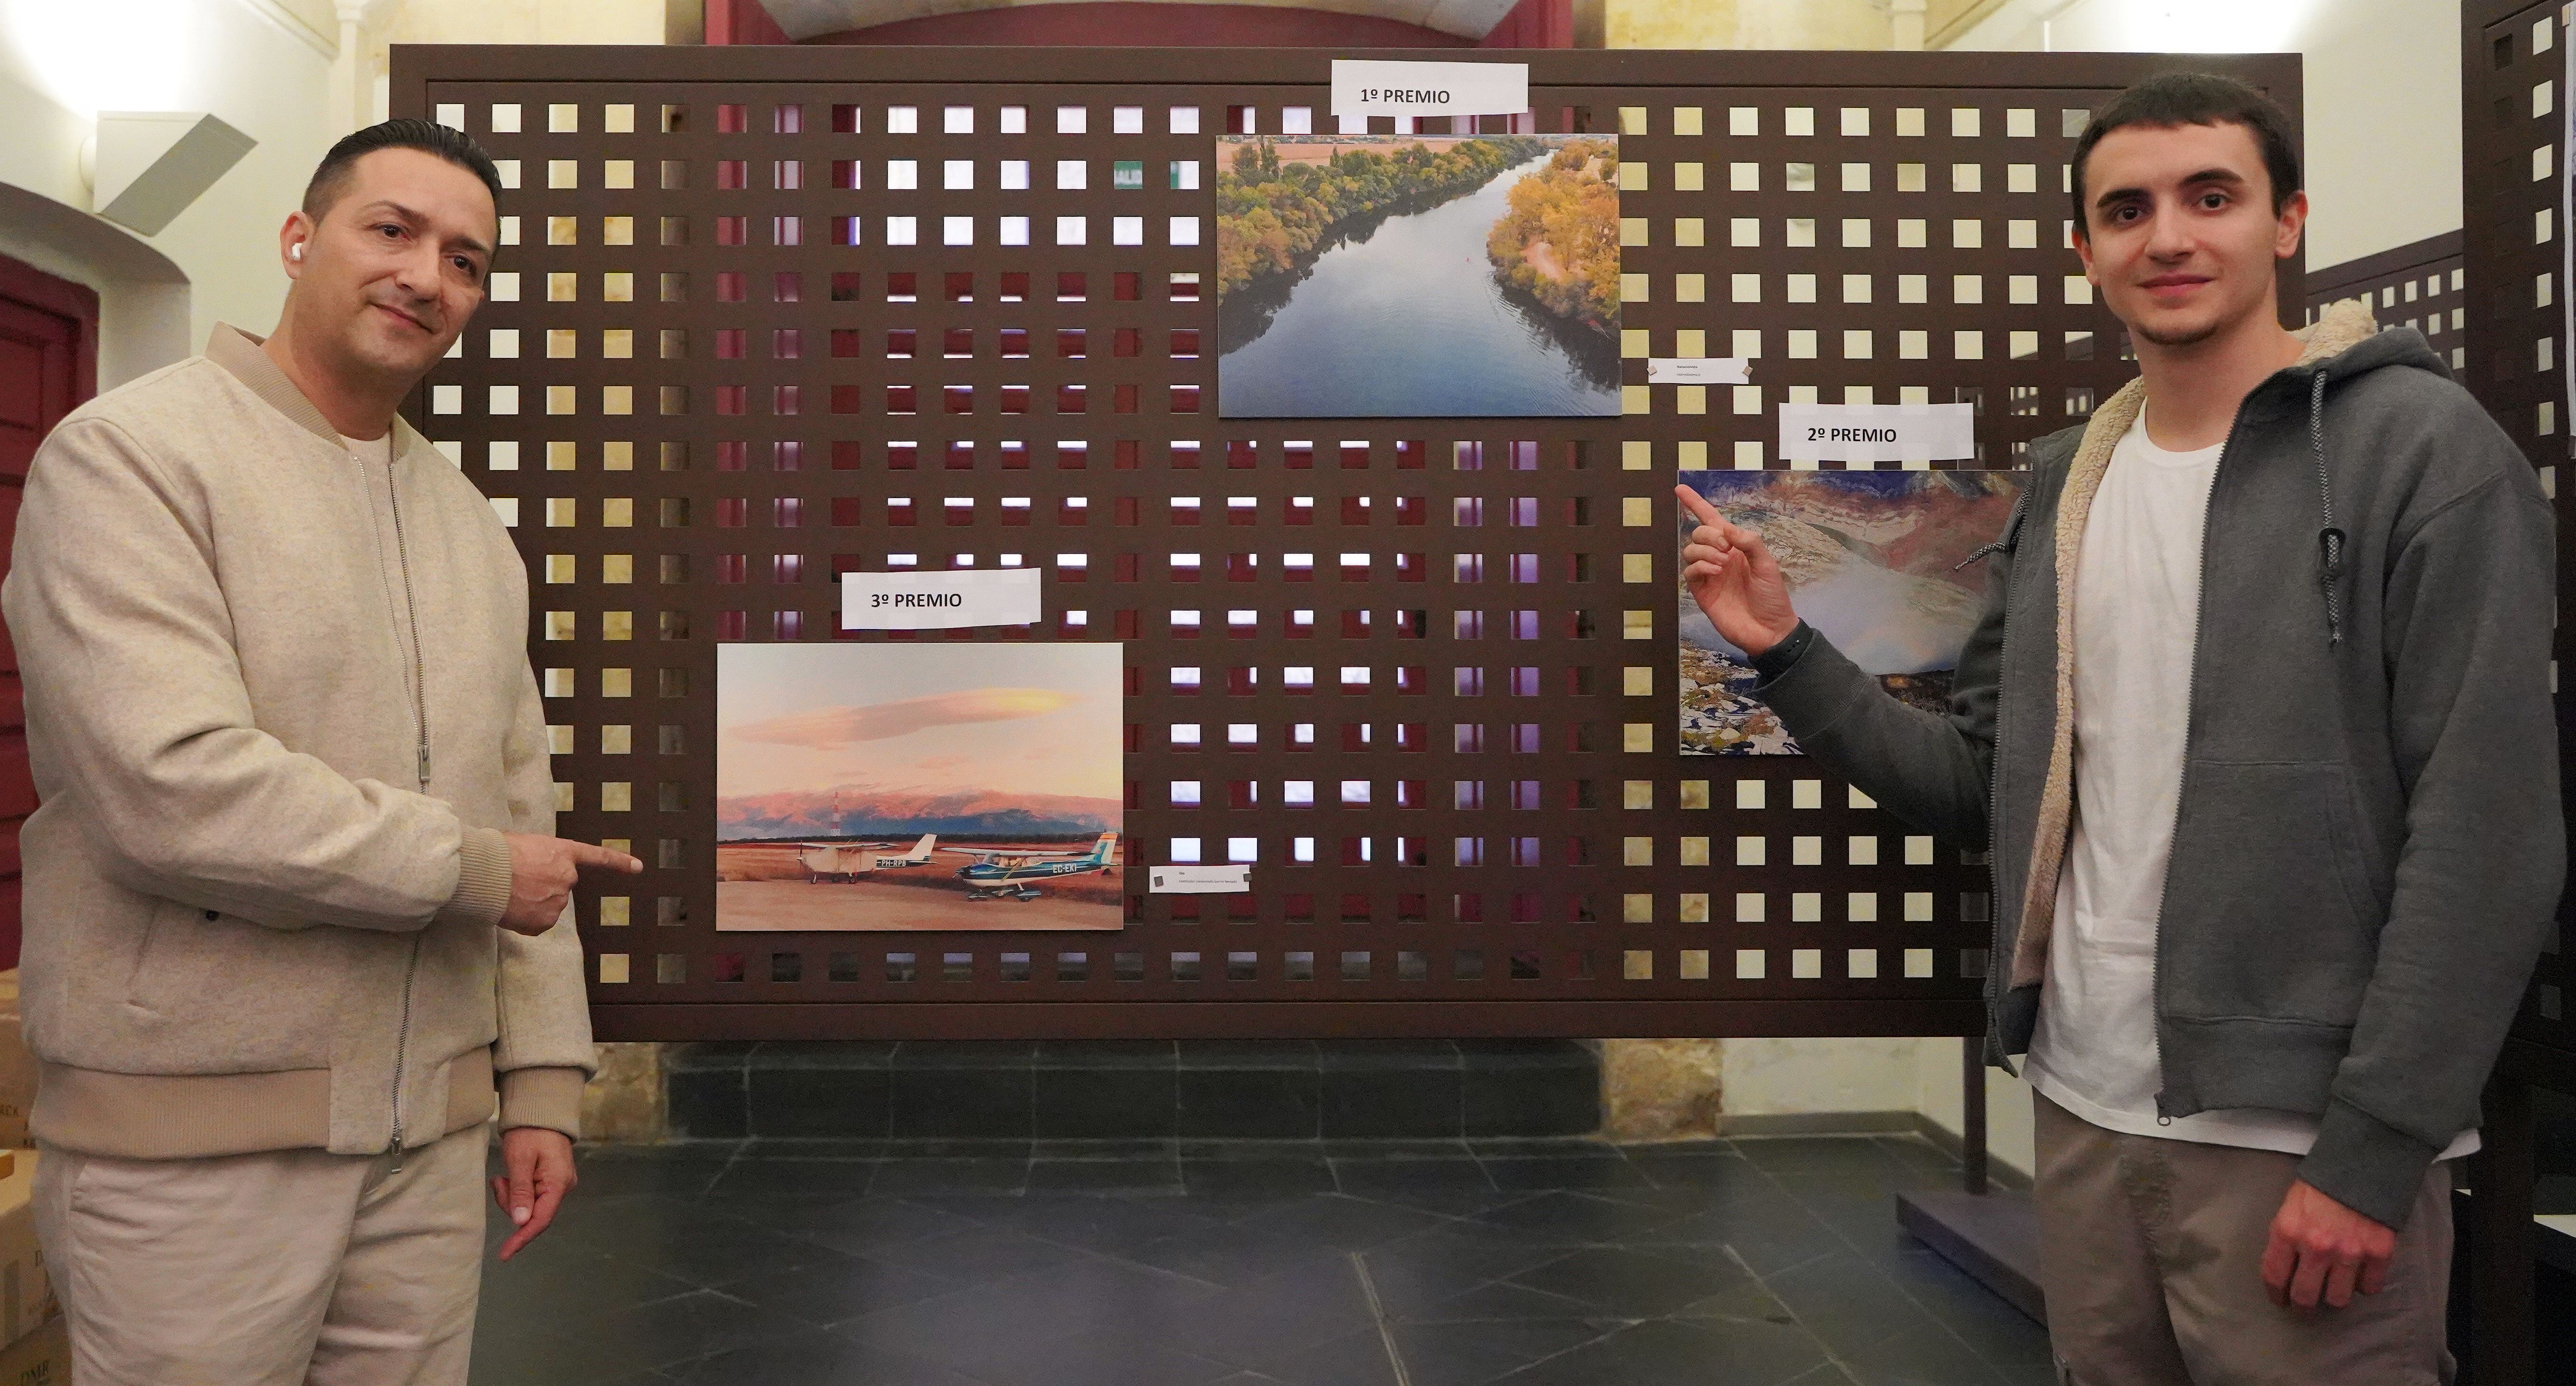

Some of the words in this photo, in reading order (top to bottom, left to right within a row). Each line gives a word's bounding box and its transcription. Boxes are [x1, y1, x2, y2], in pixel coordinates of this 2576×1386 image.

[1361, 89, 1378, 102] 1º
[1384, 89, 1450, 104] PREMIO
[1808, 427, 1825, 441] 2º
[1831, 428, 1896, 443] PREMIO
[871, 594, 889, 608] 3º
[895, 593, 962, 607] PREMIO
